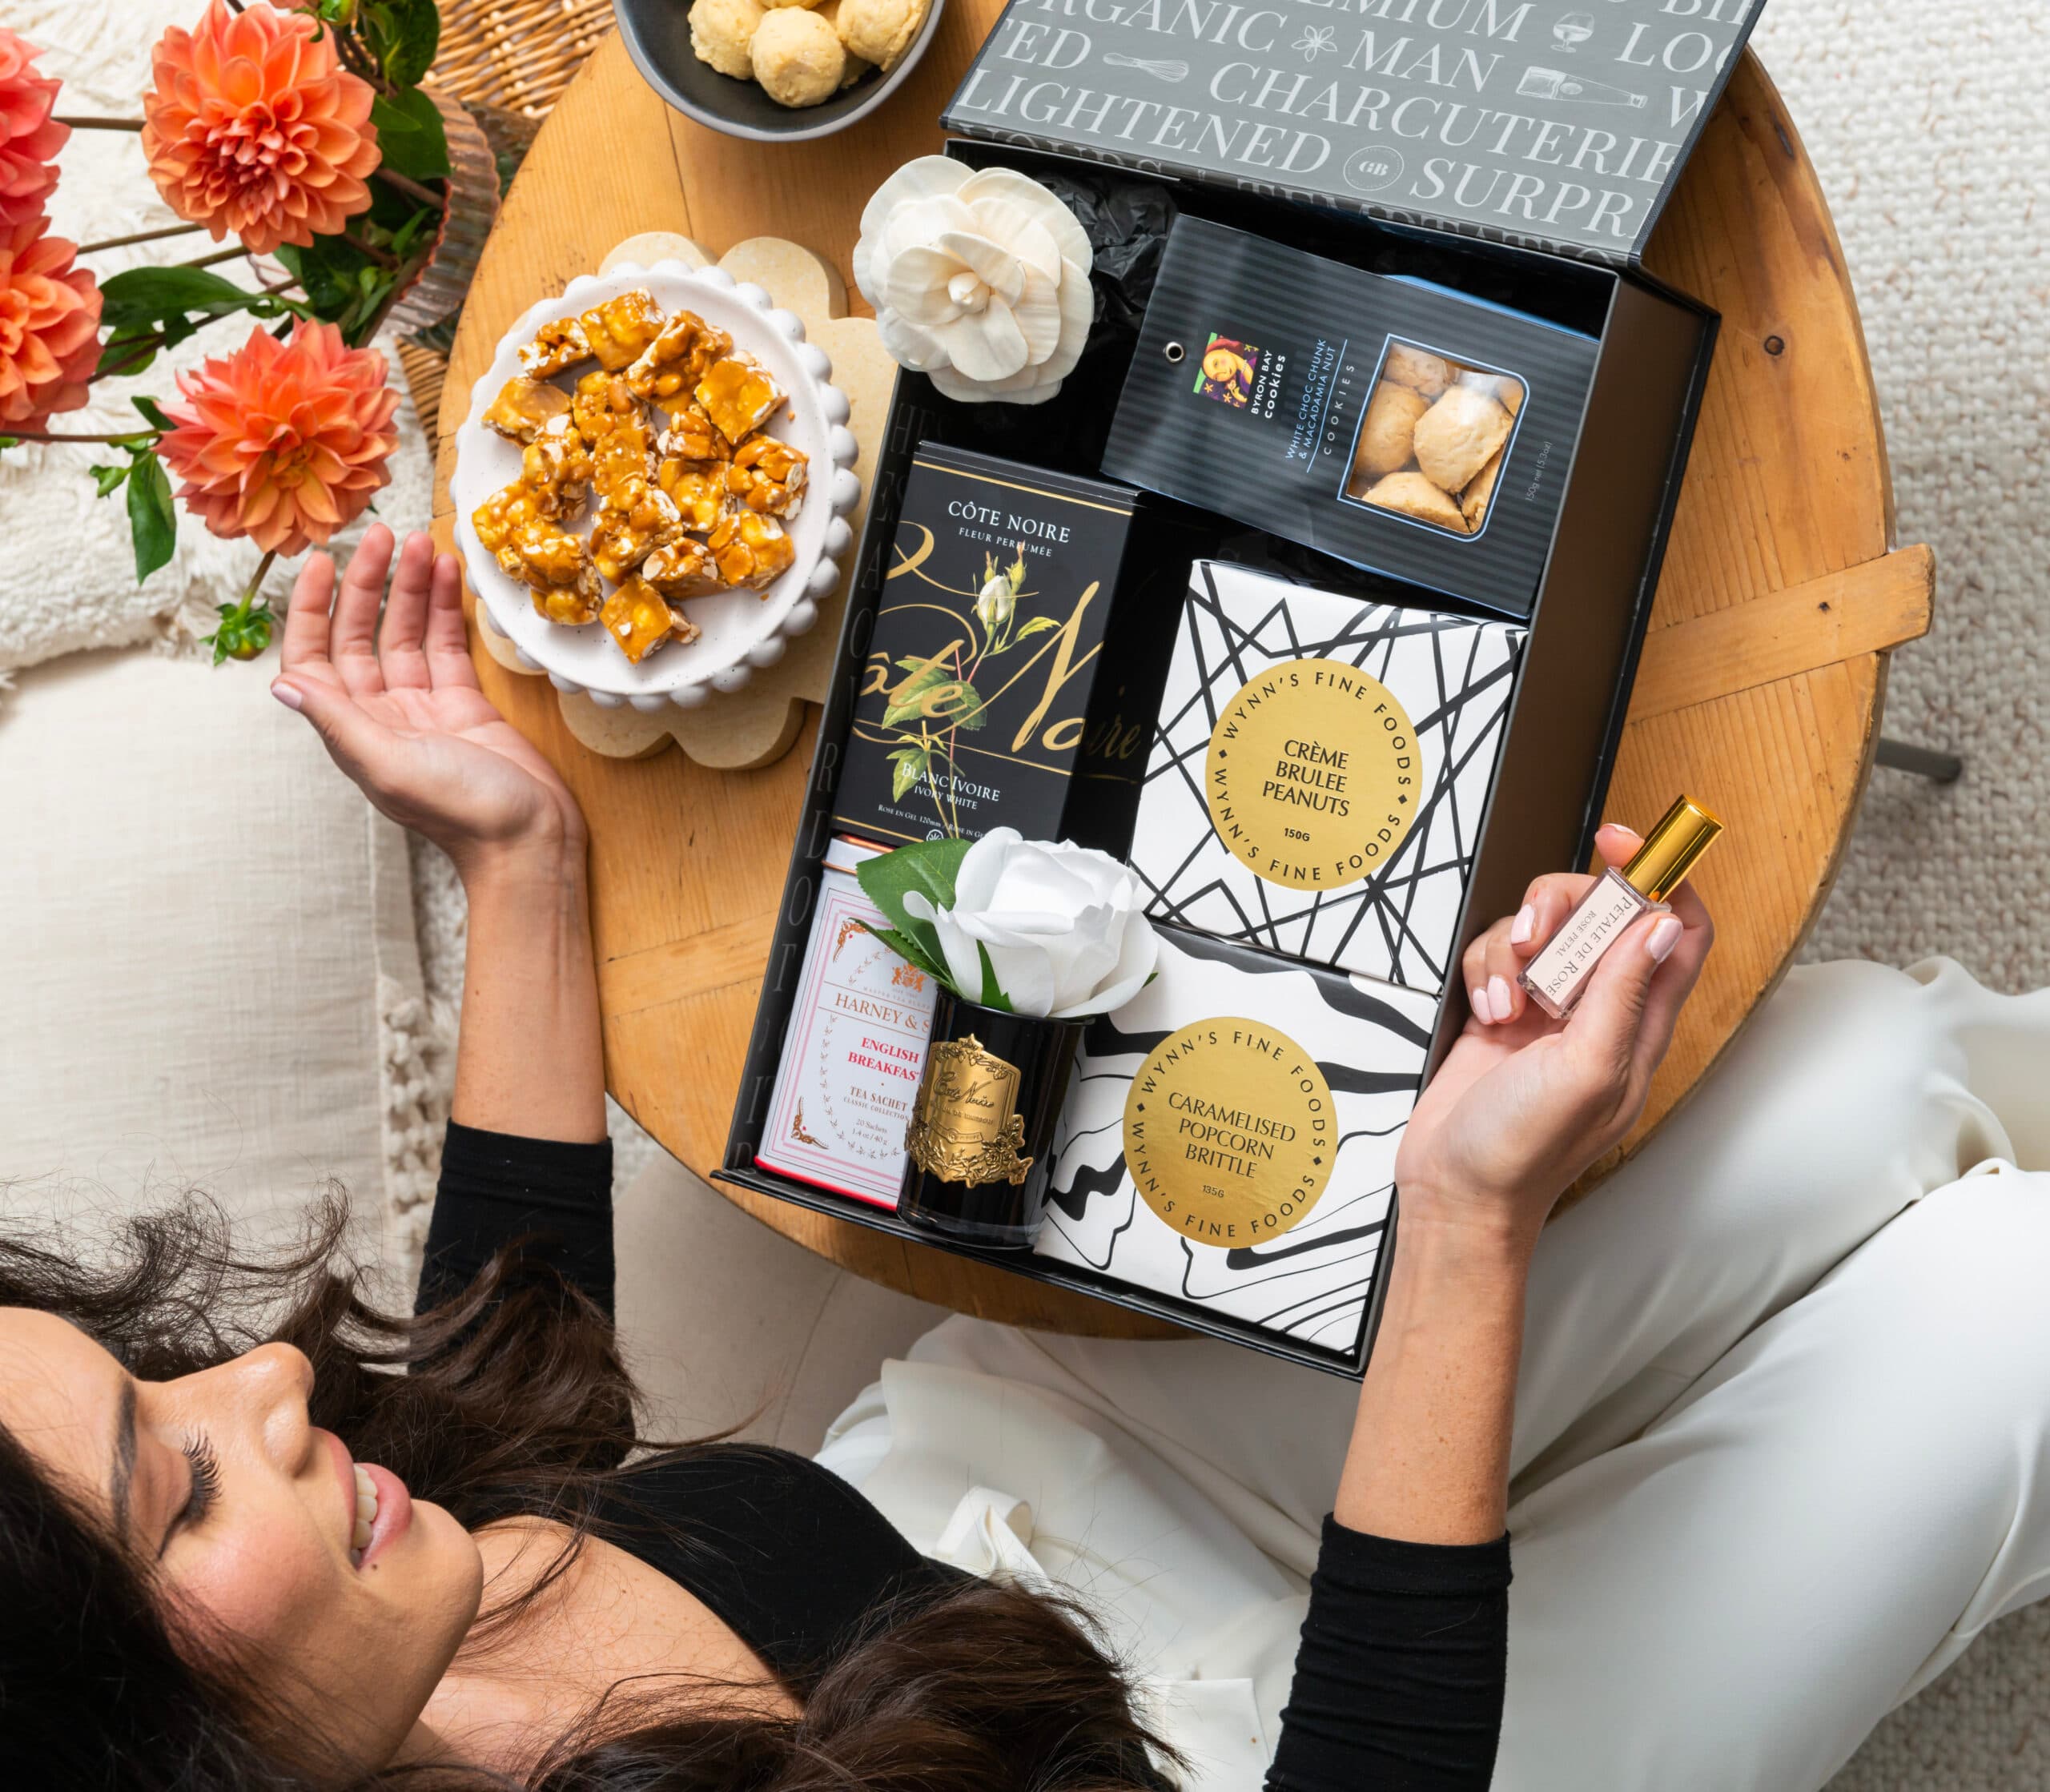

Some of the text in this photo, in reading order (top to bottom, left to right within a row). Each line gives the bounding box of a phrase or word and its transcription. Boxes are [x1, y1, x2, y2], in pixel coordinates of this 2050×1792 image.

[999, 18, 1091, 69] ED
[1015, 0, 1288, 52] GANIC
[1342, 29, 1504, 93] MAN
[956, 69, 1331, 174] LIGHTENED
[1210, 62, 1682, 184] CHARCUTERIE
[1251, 349, 1273, 415] BYRON BAY
[1284, 339, 1326, 460] WHITE CHOC CHUNK
[1298, 347, 1336, 460] & MACADAMIA NUT
[1324, 364, 1355, 456] COOKIES
[947, 500, 1071, 544] CÔTE NOIRE
[959, 527, 992, 544] FLEUR
[1223, 671, 1412, 786] WYNN'S FINE FOODS
[1284, 739, 1350, 769] CRÈME
[902, 761, 1001, 802] BLANC IVOIRE
[1276, 760, 1348, 793] BRULEE
[895, 808, 903, 817] EN
[914, 786, 979, 810] IVORY WHITE
[1262, 780, 1351, 817] PEANUTS
[1214, 768, 1401, 881] WYNN'S FINE FOODS
[1284, 827, 1311, 842] 150G
[1555, 910, 1598, 958] ROSE PETAL
[1574, 942, 1593, 962] DE
[1546, 960, 1579, 998] ROSE
[835, 992, 903, 1025] HARNEY
[905, 1014, 918, 1031] &
[861, 1037, 920, 1064] ENGLISH
[843, 1096, 869, 1110] CLASSIC
[850, 1086, 908, 1112] TEA SACHET
[1141, 1031, 1326, 1147] WYNN'S FINE FOODS
[1168, 1091, 1296, 1143] CARAMELISED
[1179, 1118, 1275, 1160] POPCORN
[1132, 1121, 1316, 1238] WYNN'S FINE FOODS
[1185, 1143, 1258, 1179] BRITTLE
[1202, 1184, 1225, 1198] 135G
